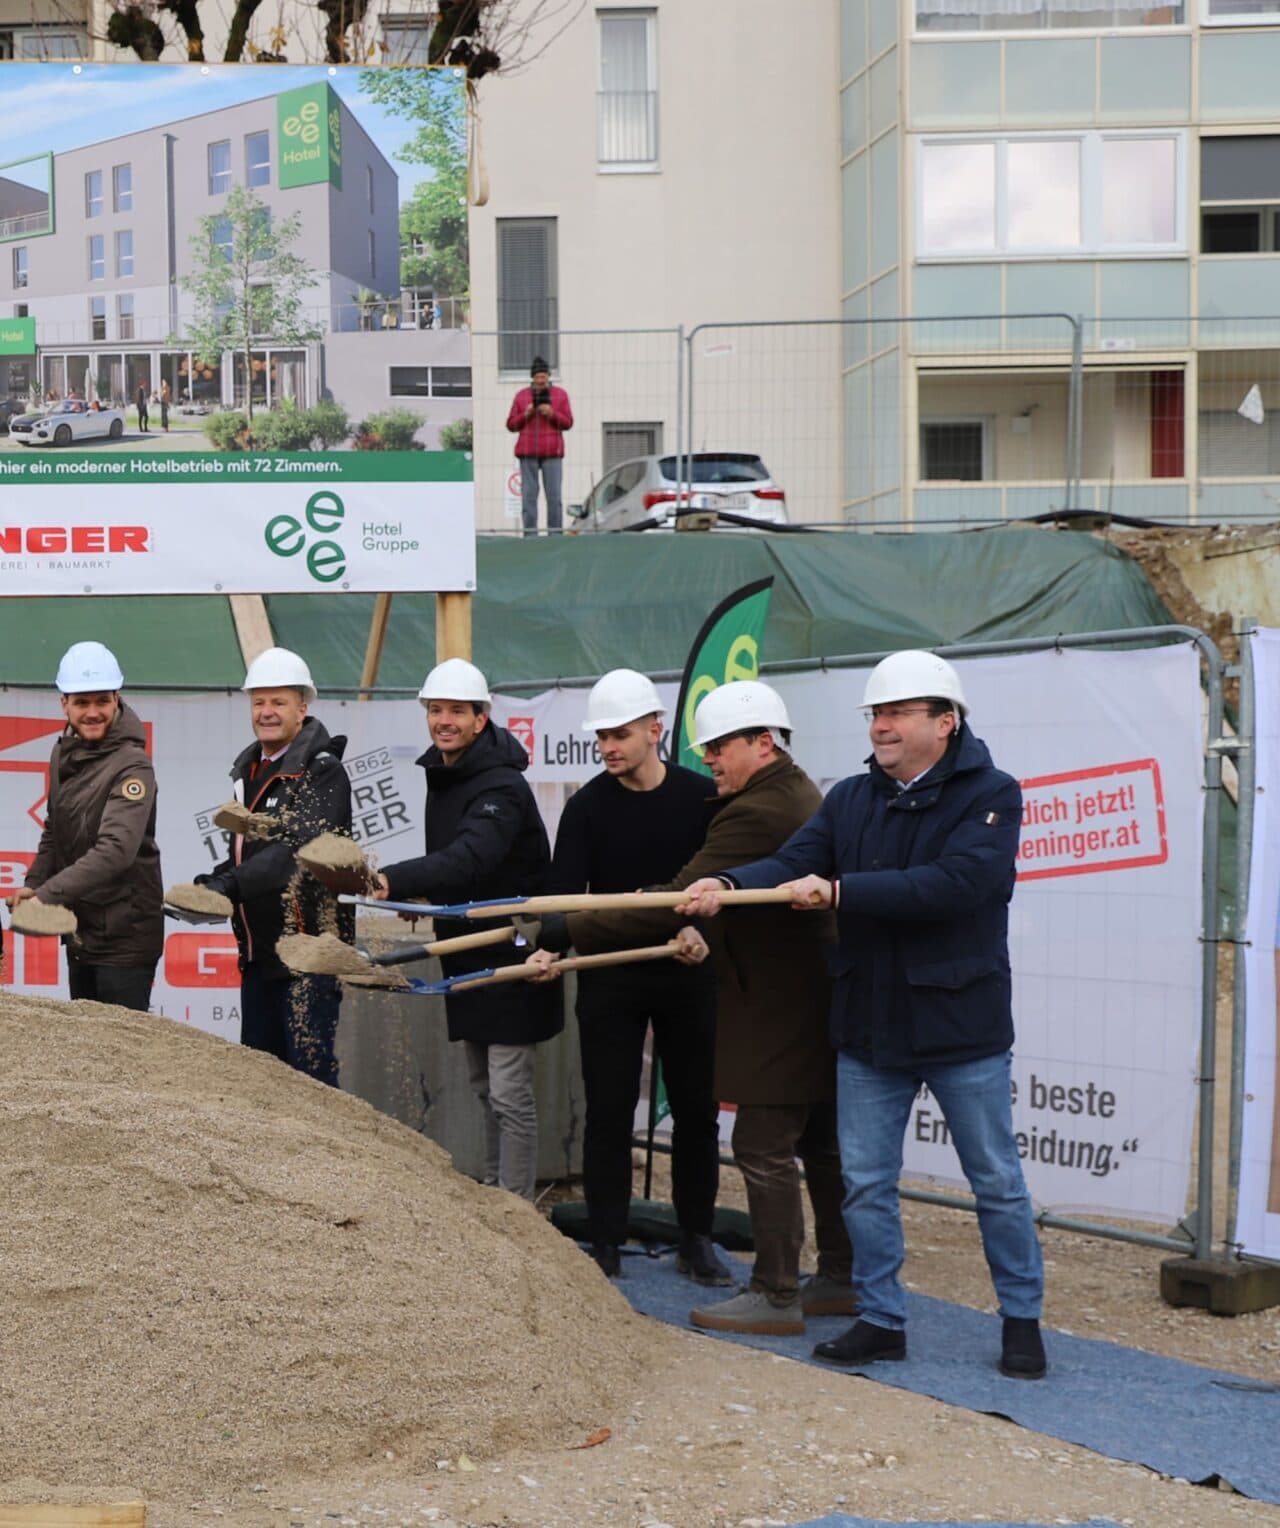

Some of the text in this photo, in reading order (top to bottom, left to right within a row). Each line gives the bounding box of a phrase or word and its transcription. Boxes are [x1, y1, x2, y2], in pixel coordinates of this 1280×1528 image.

[283, 145, 321, 165] Hotel
[29, 460, 52, 474] ein
[55, 460, 126, 474] moderner
[130, 459, 221, 473] Hotelbetrieb
[227, 459, 251, 473] mit
[253, 458, 271, 473] 72
[274, 458, 343, 473] Zimmern.
[362, 522, 402, 536] Hotel
[362, 537, 420, 553] Gruppe
[48, 560, 112, 570] BAUMARKT
[346, 751, 392, 777] 1862
[1075, 784, 1135, 824] jetzt!
[1016, 819, 1140, 860] eninger.at
[1030, 1074, 1116, 1119] beste
